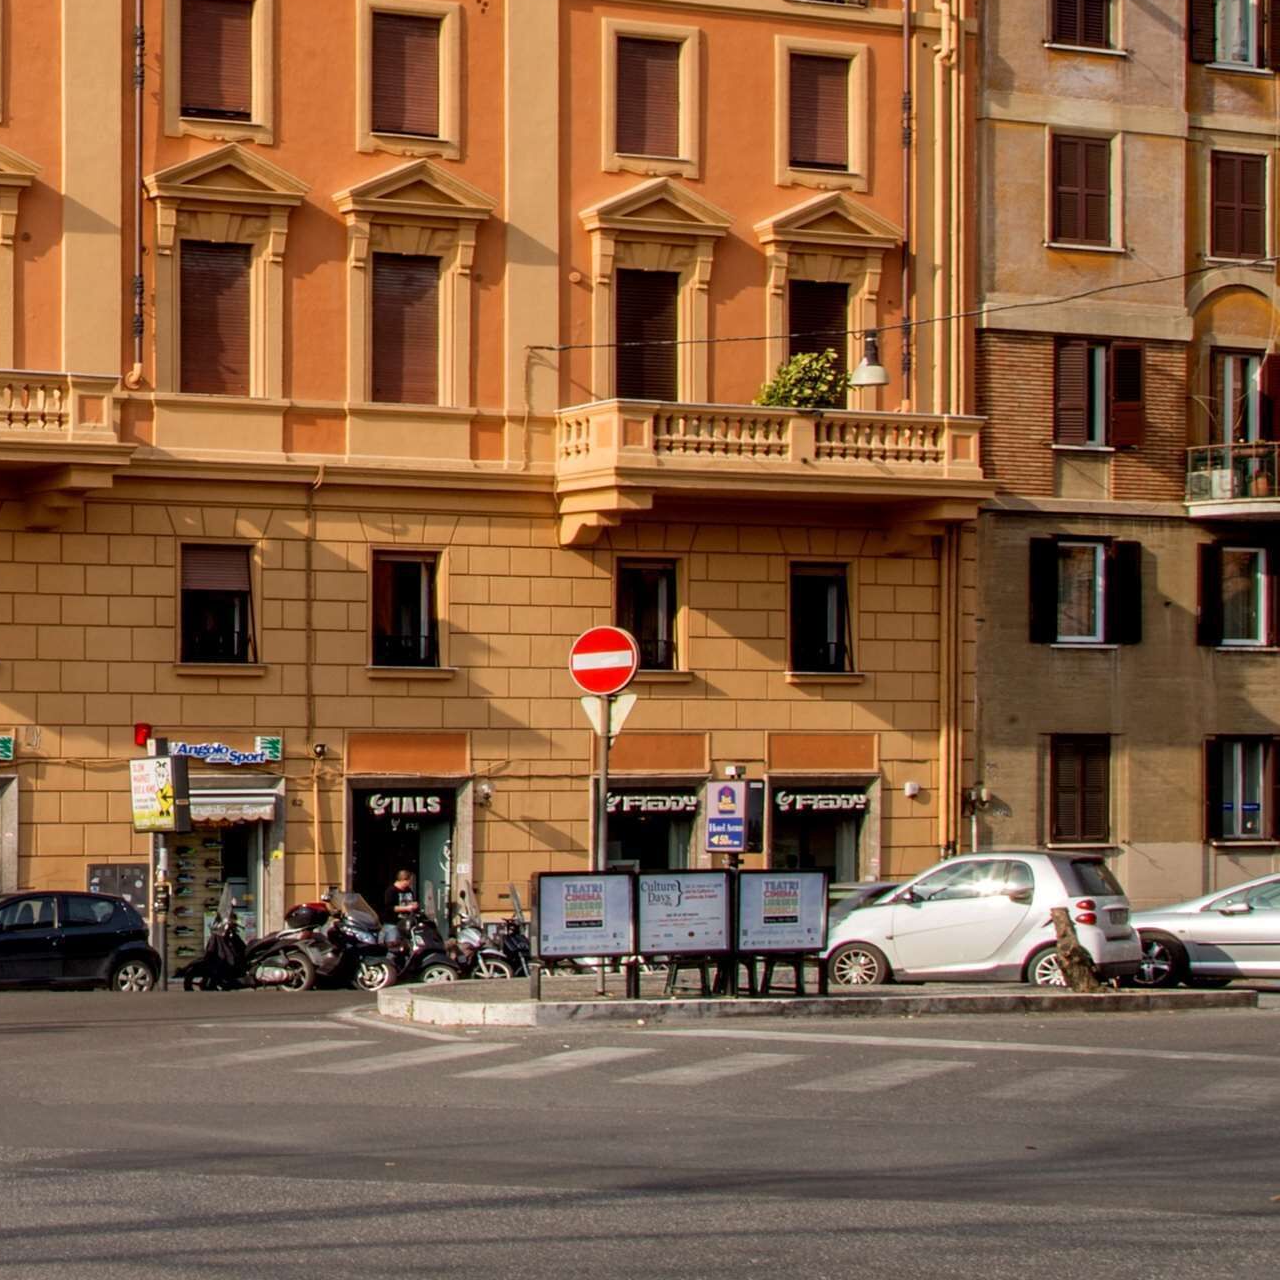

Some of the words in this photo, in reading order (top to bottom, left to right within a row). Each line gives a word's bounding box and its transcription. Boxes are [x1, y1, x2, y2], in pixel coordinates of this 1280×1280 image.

[229, 751, 266, 763] Sport
[623, 795, 698, 812] FREDDY
[795, 793, 868, 810] FREDDY
[565, 883, 603, 893] TEATRI
[641, 880, 677, 892] Culture
[764, 881, 800, 890] TEATRI
[648, 892, 672, 903] Days
